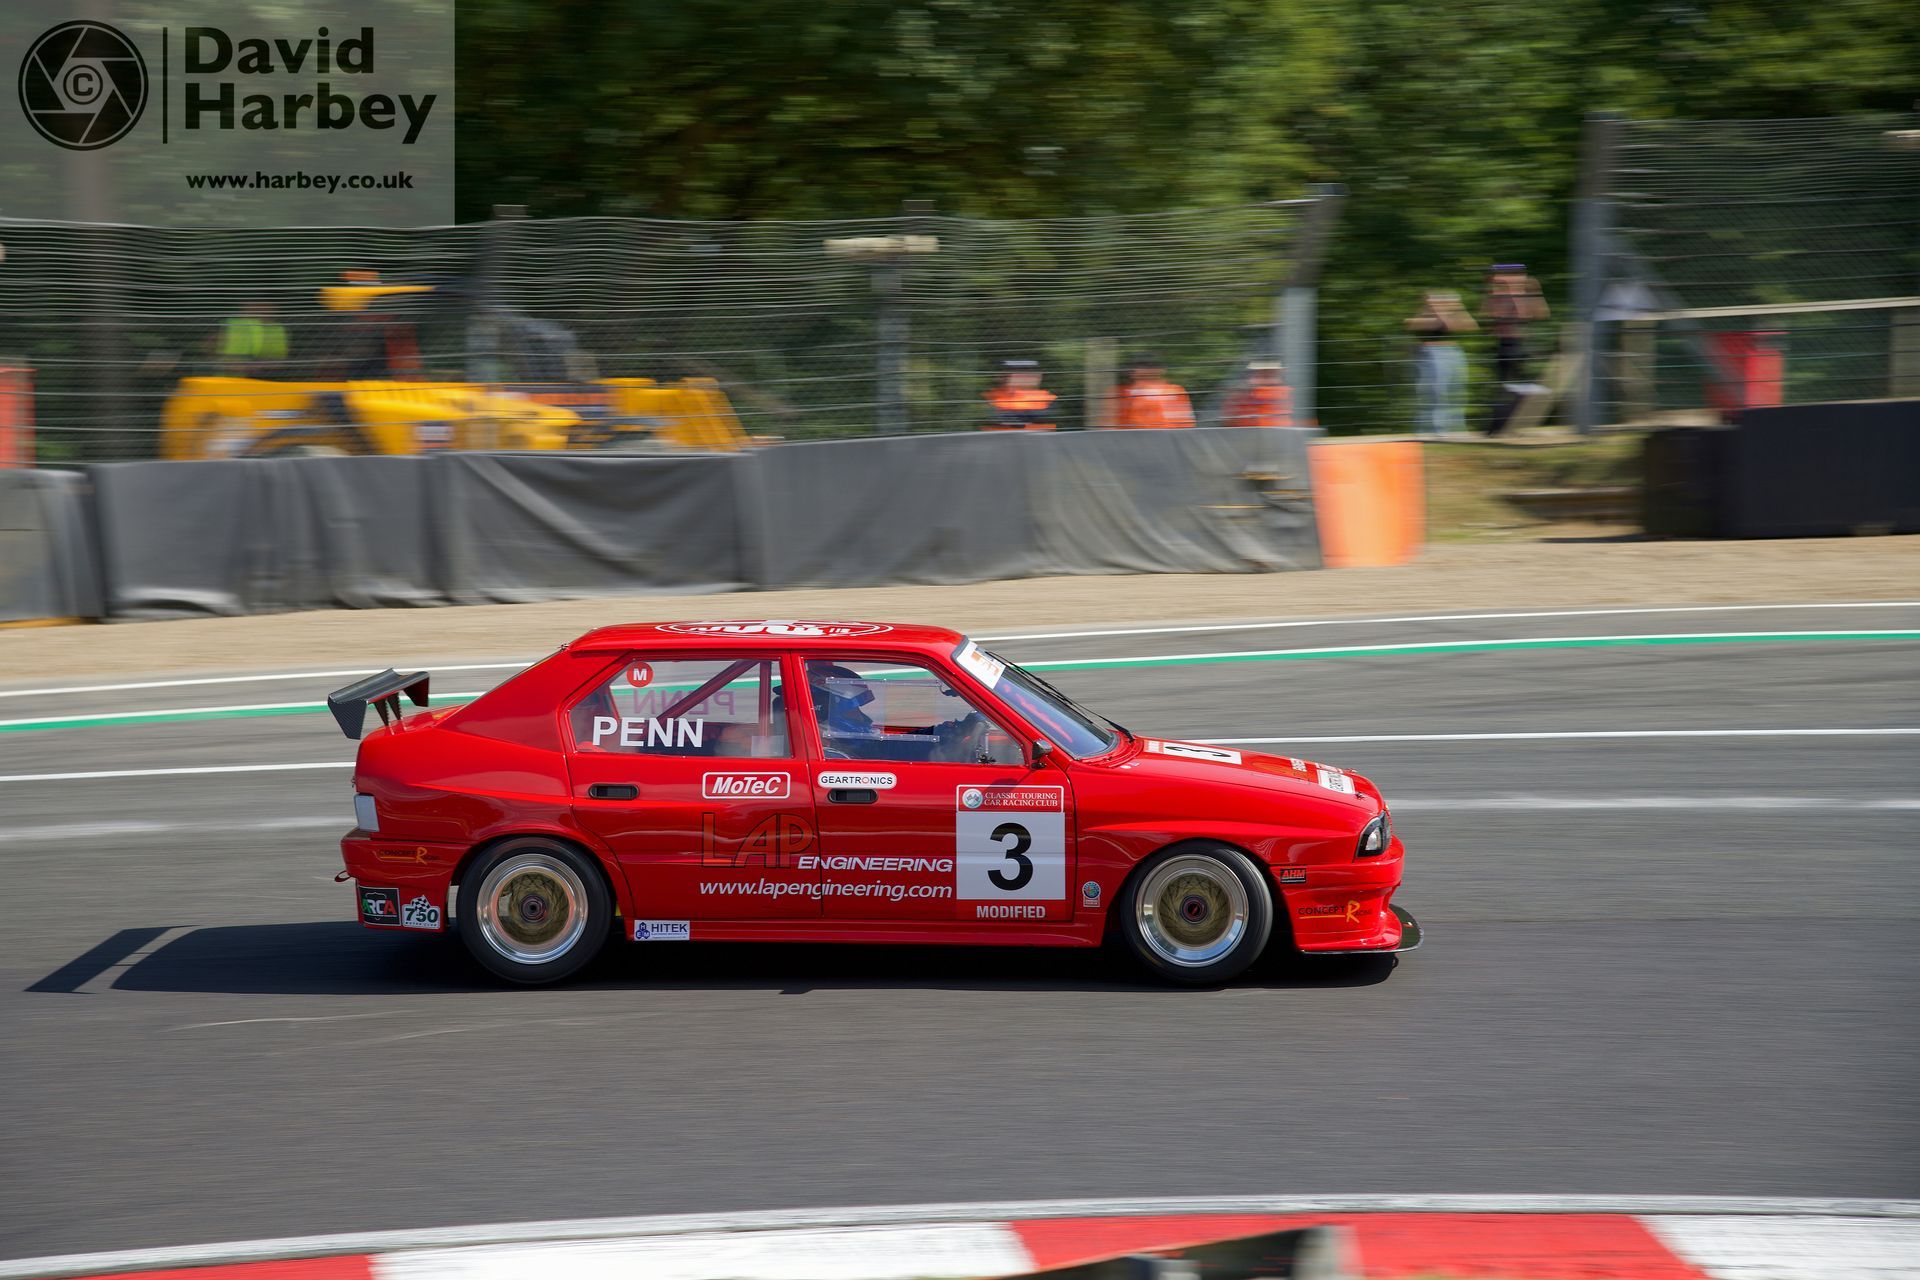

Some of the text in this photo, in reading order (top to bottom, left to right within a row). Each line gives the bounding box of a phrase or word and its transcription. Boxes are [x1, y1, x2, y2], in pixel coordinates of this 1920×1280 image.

[633, 668, 647, 681] M
[592, 716, 703, 748] PENN
[712, 777, 780, 794] MoTeC
[821, 775, 893, 785] GEARTRONICS
[702, 811, 817, 868] LAP
[798, 856, 952, 872] ENGINEERING
[987, 822, 1033, 891] 3
[700, 878, 952, 901] www.lapengineering.com
[362, 899, 396, 915] ARCA
[406, 908, 438, 922] 750
[976, 905, 1045, 918] MODIFIED
[651, 923, 688, 932] HITEK
